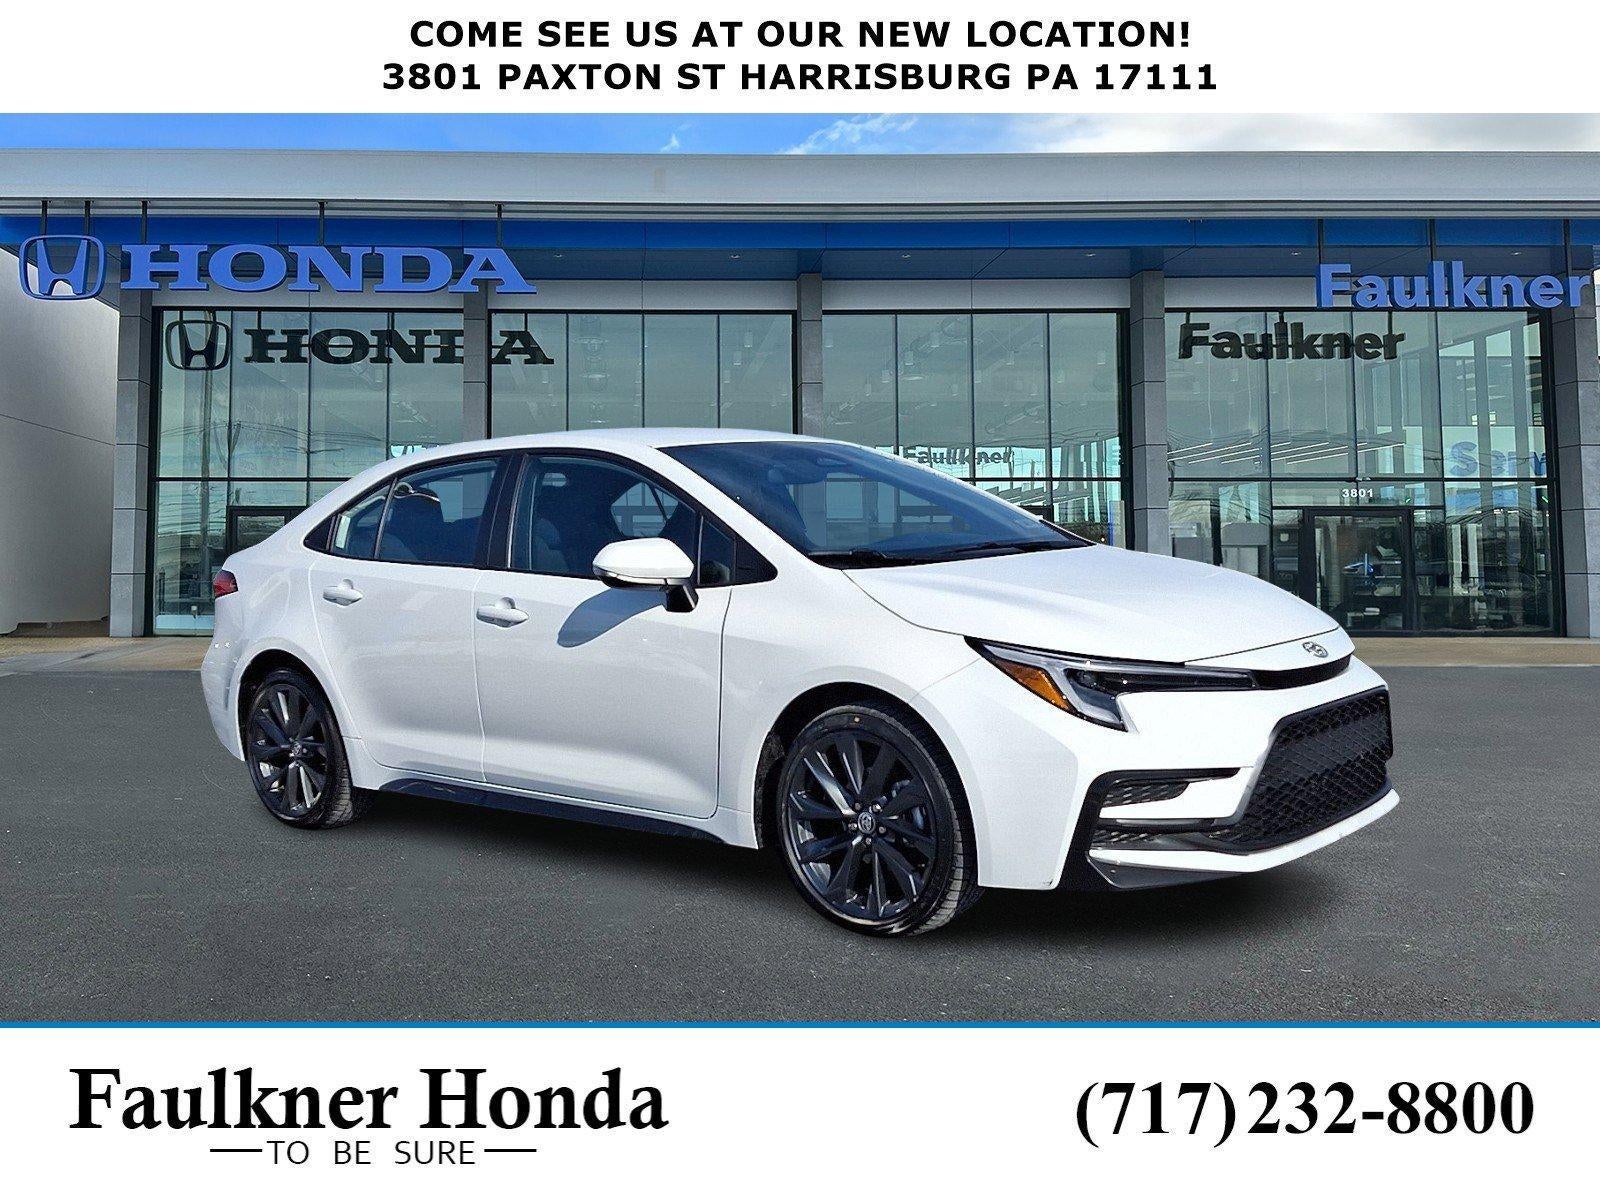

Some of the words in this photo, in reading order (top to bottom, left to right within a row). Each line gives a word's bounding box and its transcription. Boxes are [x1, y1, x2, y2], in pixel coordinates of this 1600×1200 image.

[121, 244, 537, 294] HONDA
[1316, 260, 1591, 309] Faulkner
[1178, 321, 1405, 360] Faulkner
[1342, 489, 1373, 498] 3801
